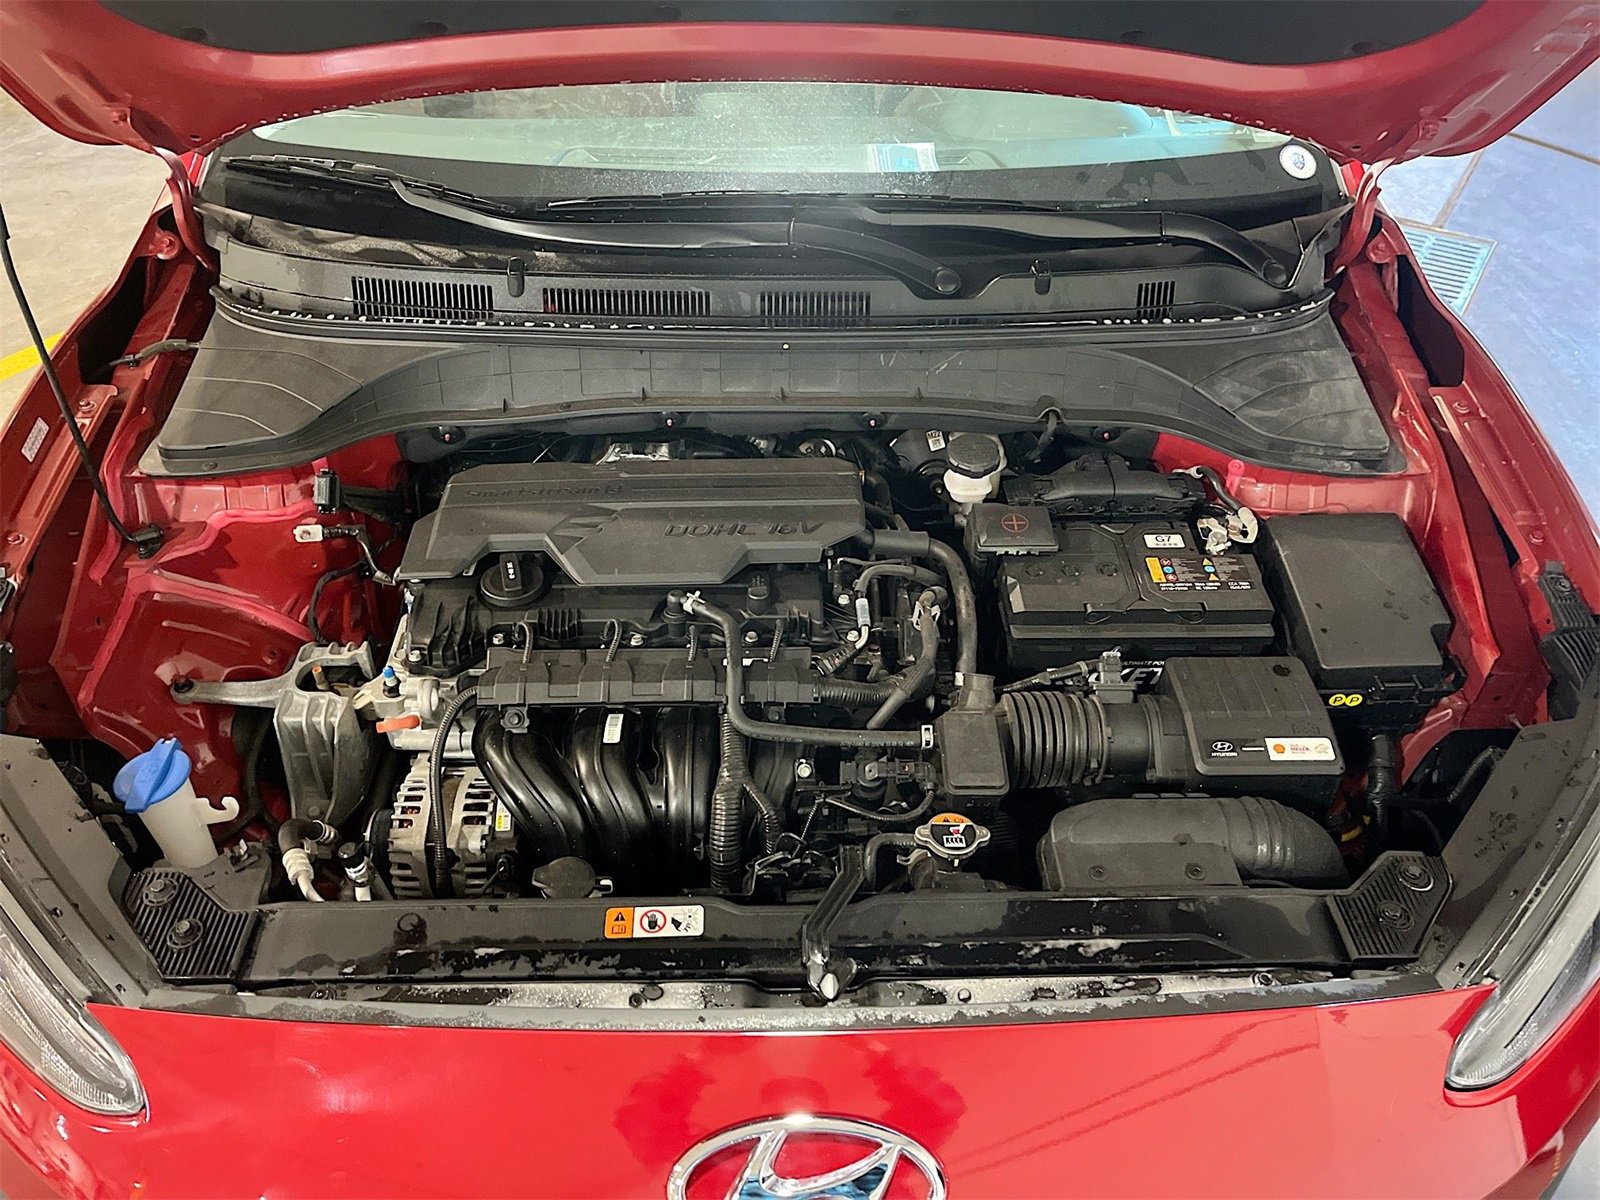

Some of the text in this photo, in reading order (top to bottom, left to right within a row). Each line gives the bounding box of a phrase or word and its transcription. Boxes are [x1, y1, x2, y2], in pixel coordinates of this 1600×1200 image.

[664, 520, 825, 538] DOHC 16V
[1154, 535, 1172, 543] G7
